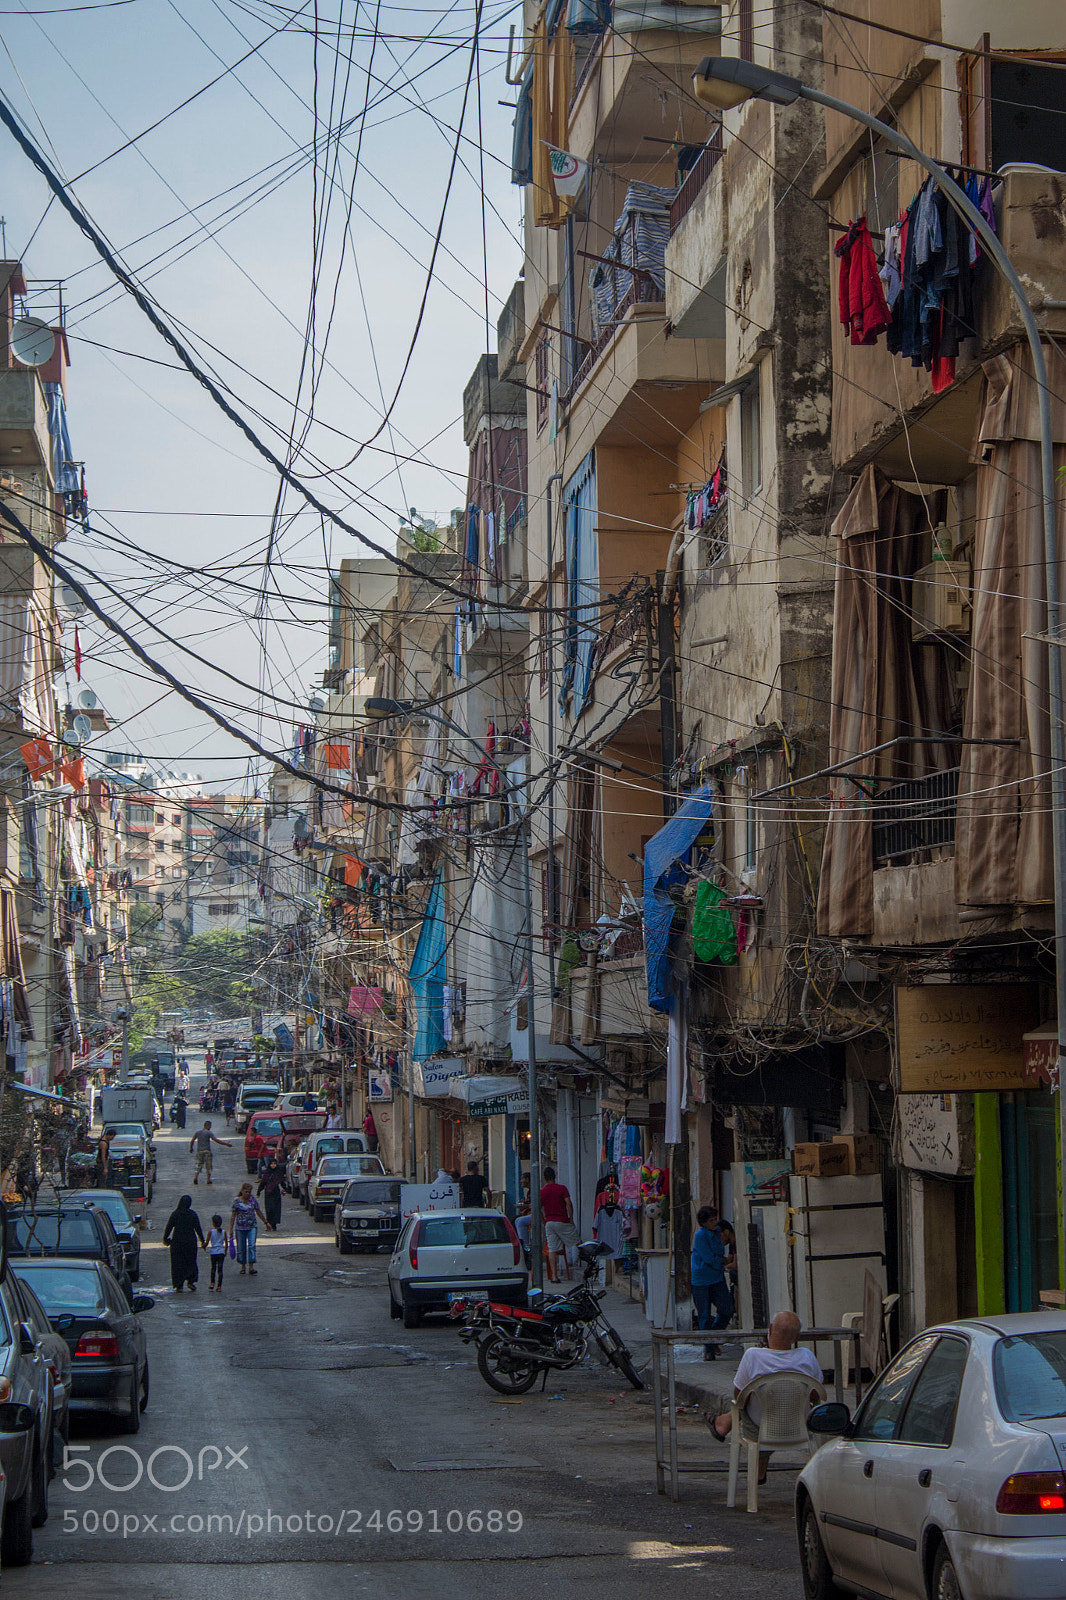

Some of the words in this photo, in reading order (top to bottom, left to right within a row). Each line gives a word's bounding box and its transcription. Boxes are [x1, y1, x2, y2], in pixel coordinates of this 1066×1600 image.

[423, 1062, 444, 1072] Salon
[425, 1070, 465, 1084] Diyar
[429, 1185, 453, 1200] فرن
